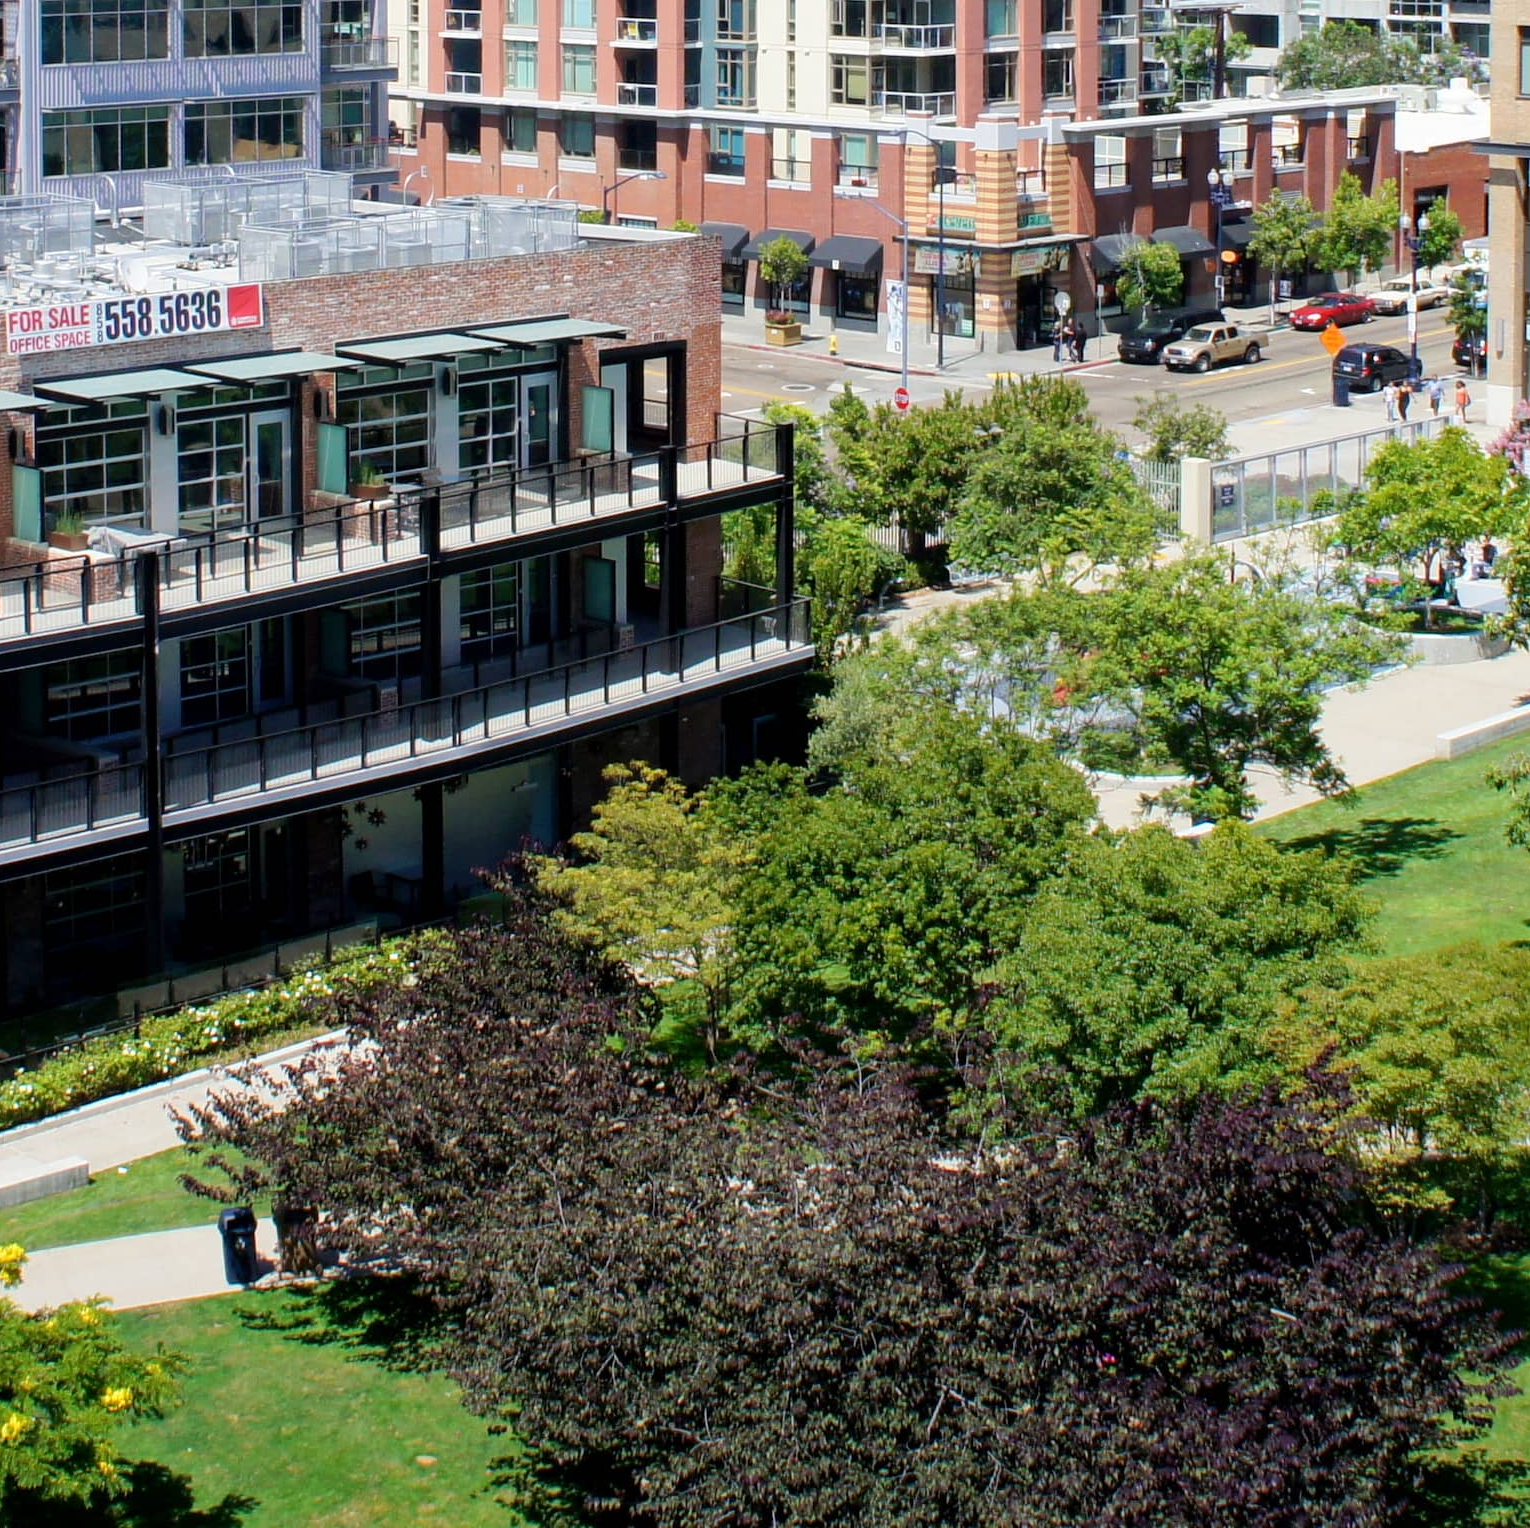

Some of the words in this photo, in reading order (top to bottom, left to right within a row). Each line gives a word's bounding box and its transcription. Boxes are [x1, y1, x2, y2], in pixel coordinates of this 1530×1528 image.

[9, 310, 43, 333] FOR
[49, 304, 90, 329] SALE
[105, 289, 221, 340] 558.5636
[10, 335, 51, 353] OFFICE
[54, 330, 91, 349] SPACE
